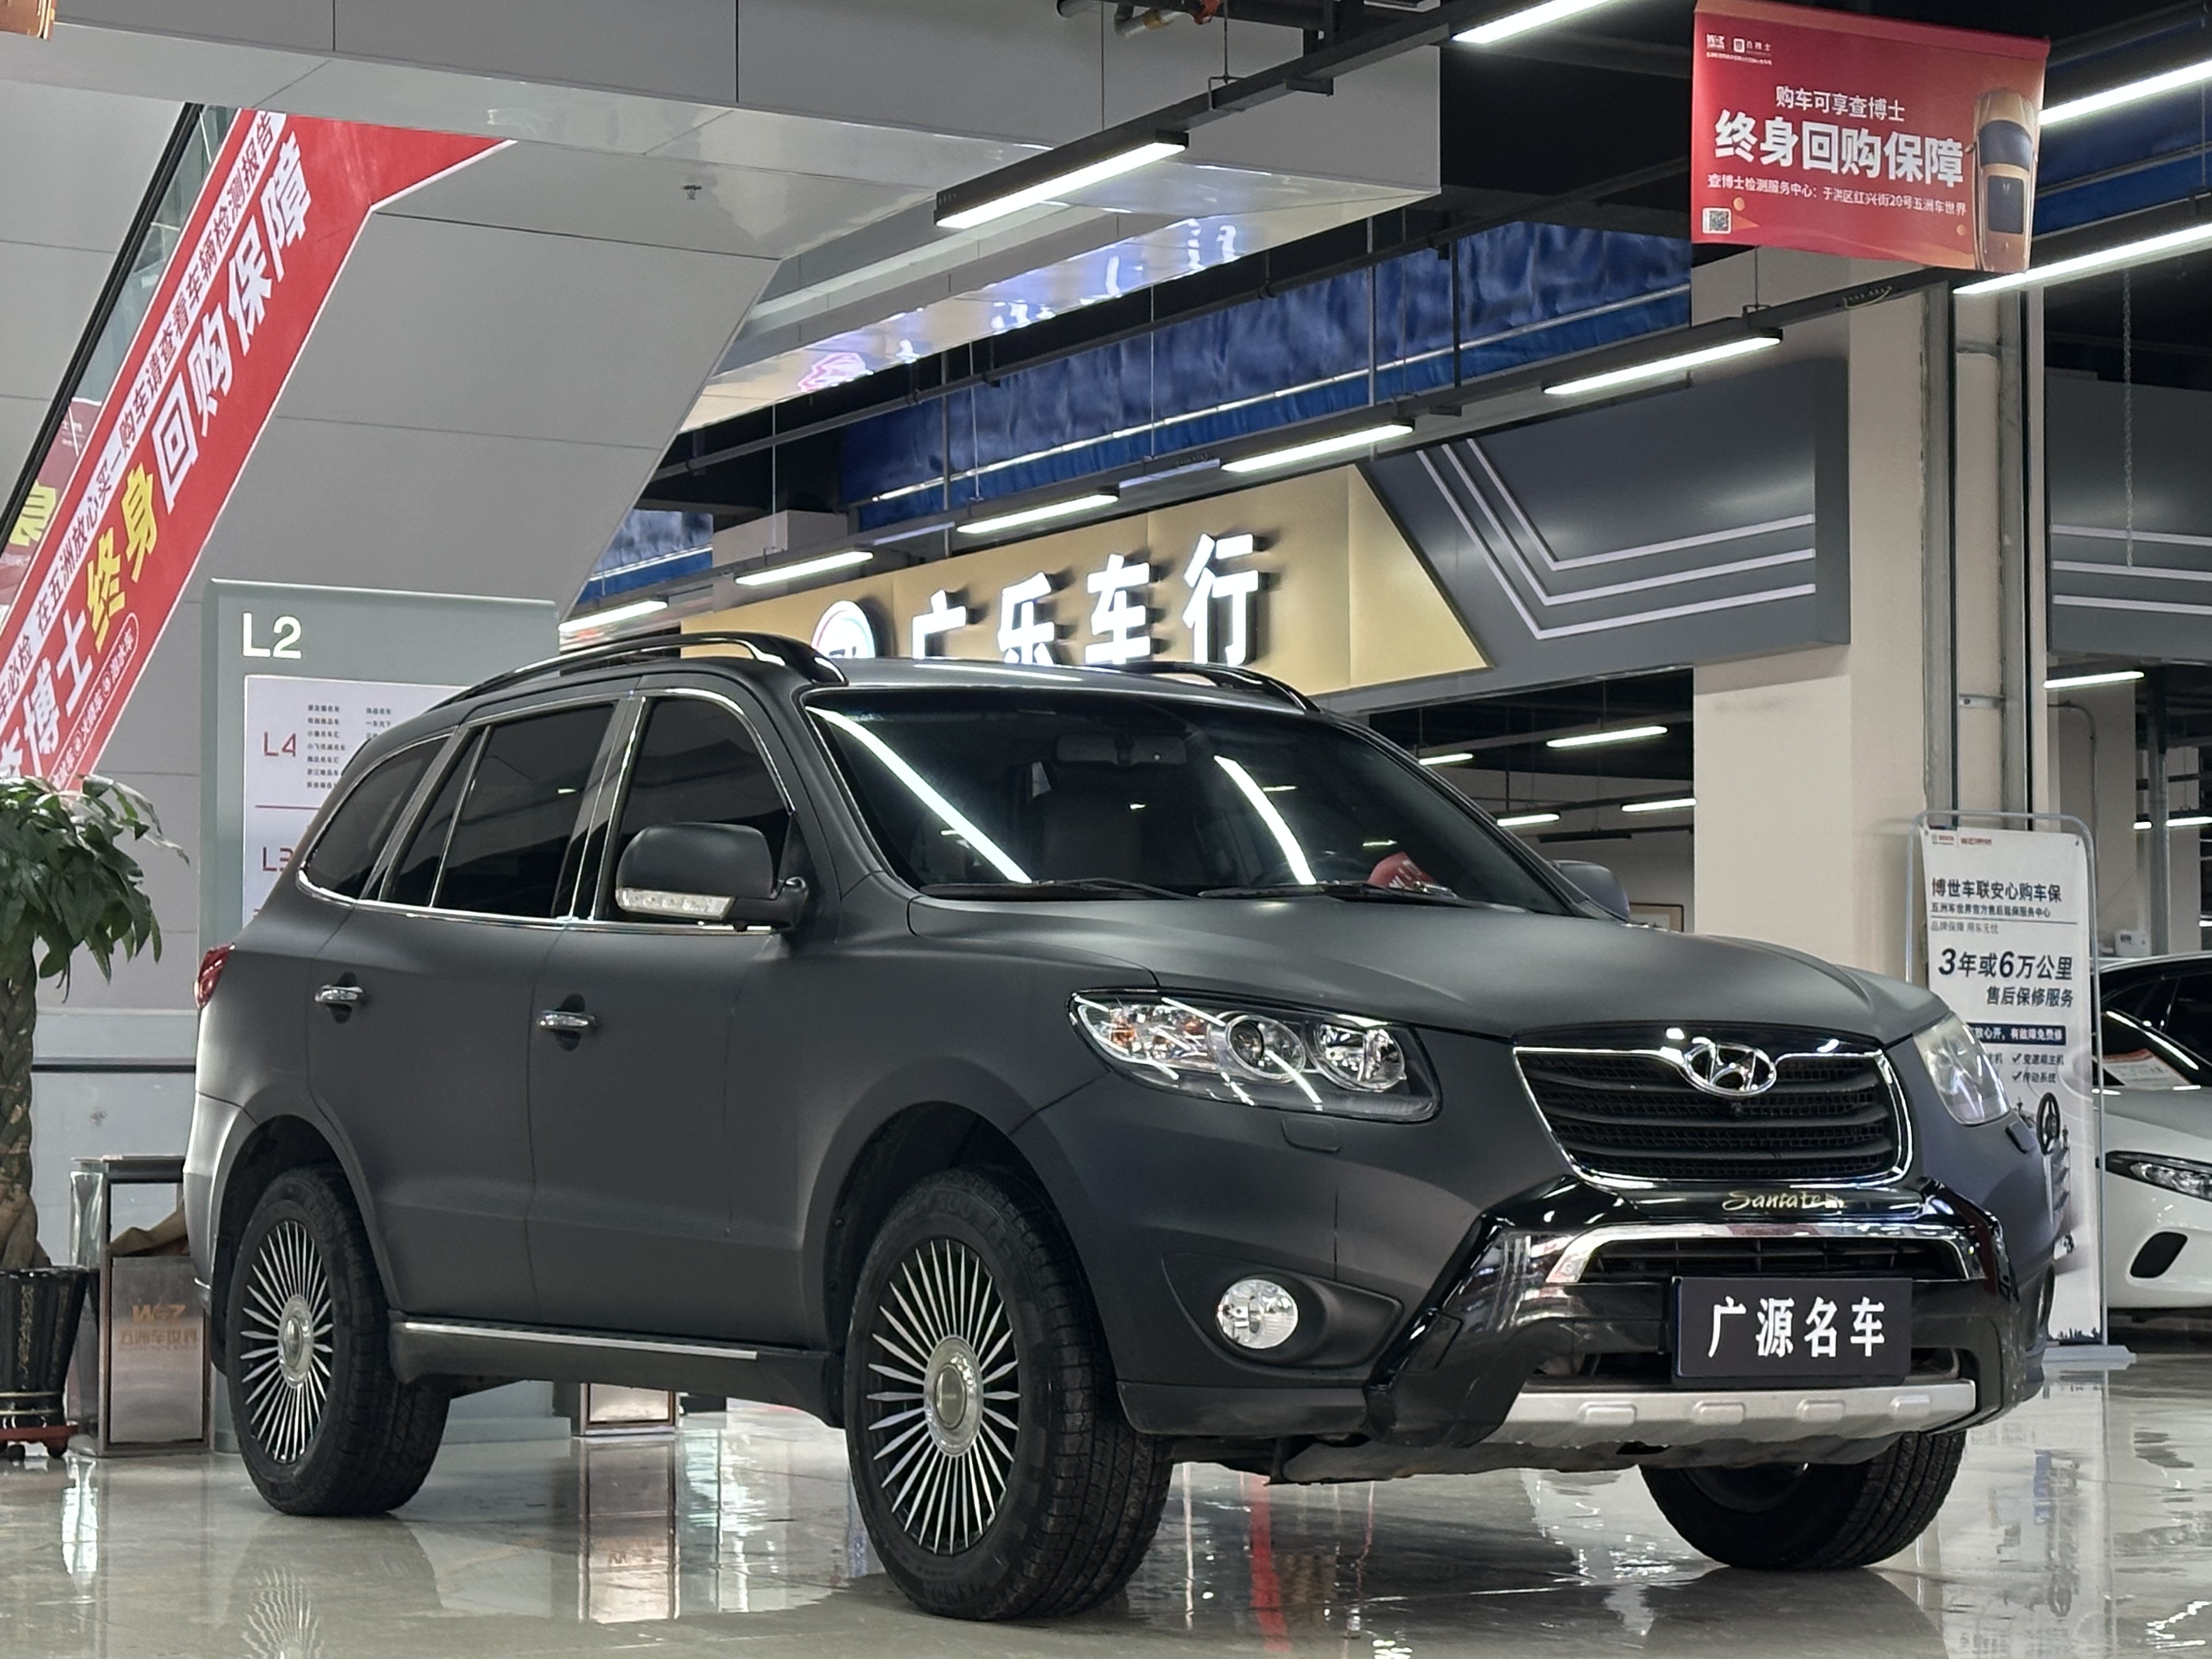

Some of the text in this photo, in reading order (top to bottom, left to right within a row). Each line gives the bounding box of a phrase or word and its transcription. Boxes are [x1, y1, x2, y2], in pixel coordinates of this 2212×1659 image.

[1775, 85, 1905, 122] 购车可享查博士
[1714, 109, 1963, 188] 终身回购保障
[911, 532, 1259, 667] 广乐车行
[243, 612, 302, 659] L2
[264, 731, 296, 757] L4
[1932, 877, 2062, 902] 博世车联安心购车保
[1938, 947, 2073, 981] 3年或6万公里
[1986, 986, 2074, 1008] 售后保修服务
[1708, 1295, 1886, 1358] 广源名车
